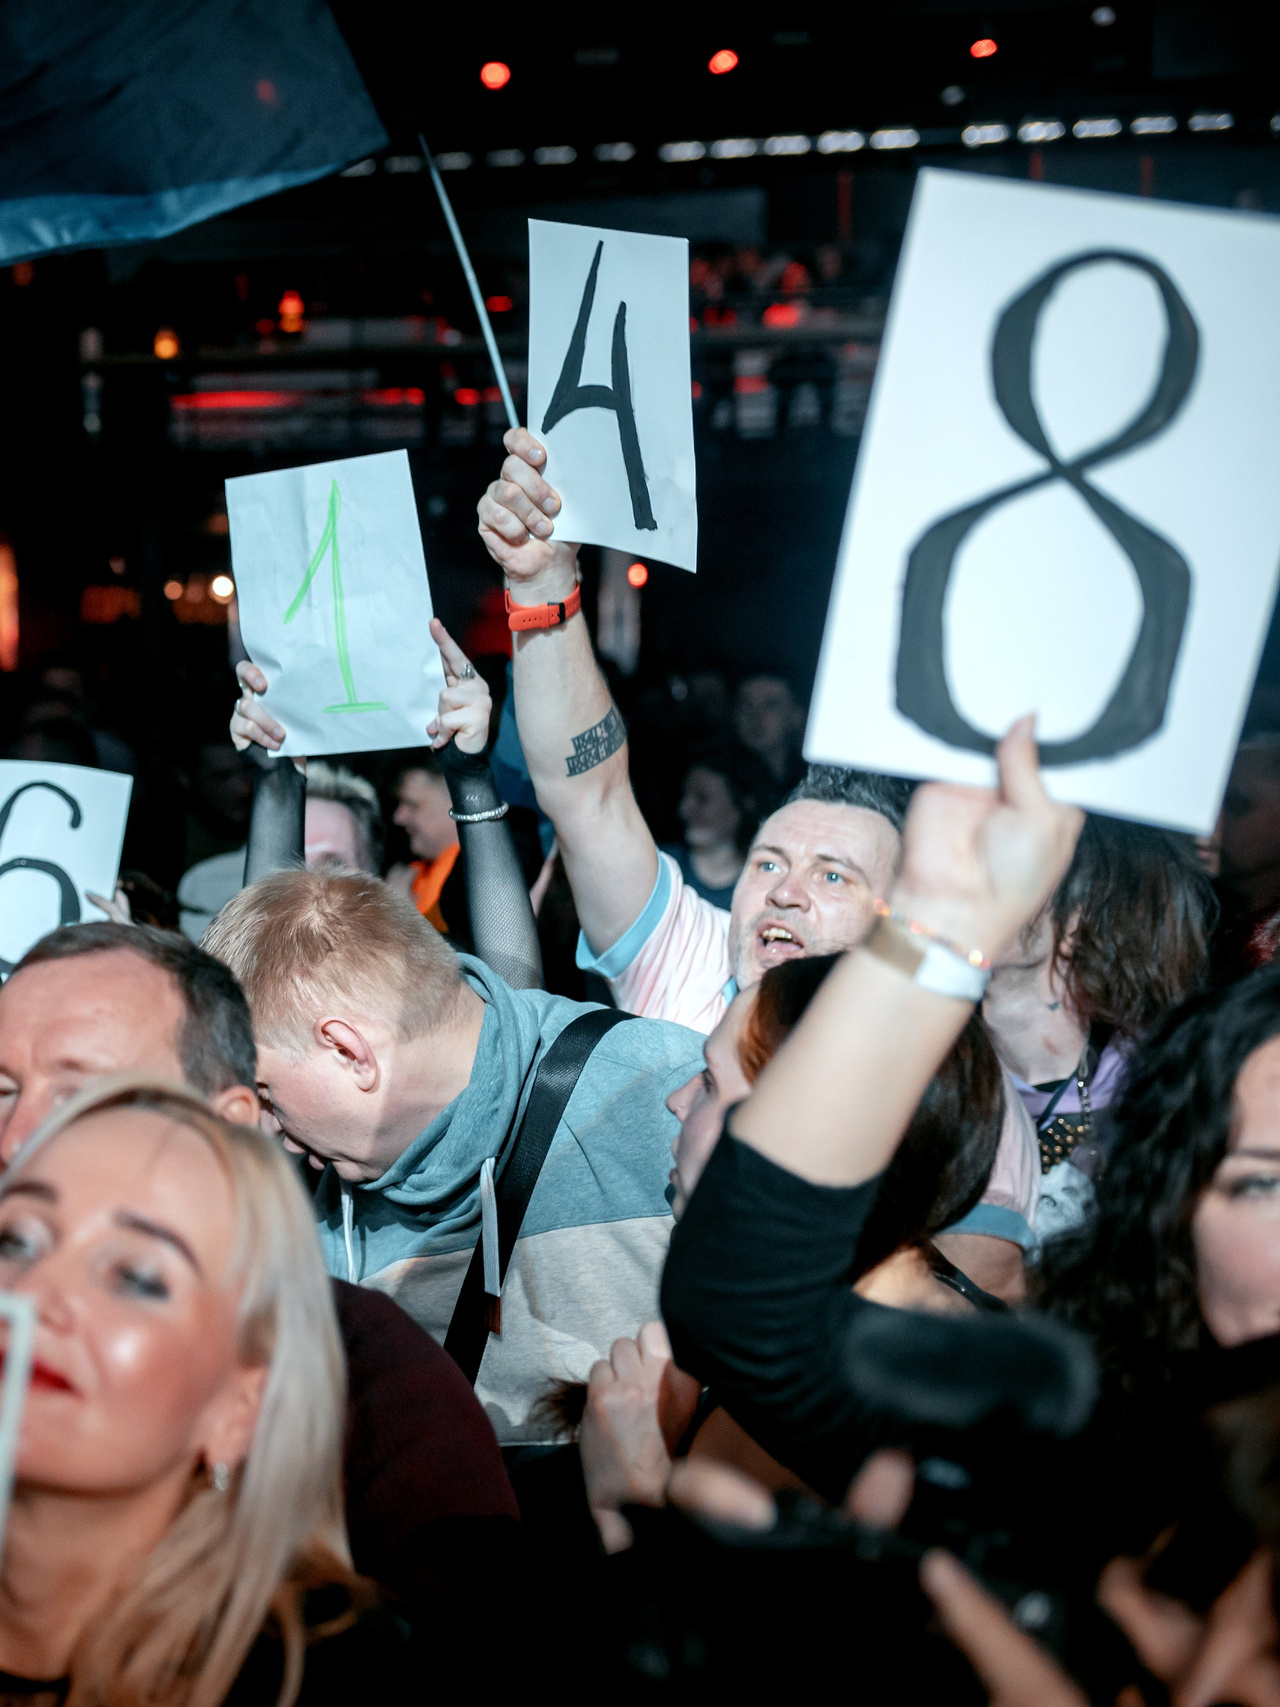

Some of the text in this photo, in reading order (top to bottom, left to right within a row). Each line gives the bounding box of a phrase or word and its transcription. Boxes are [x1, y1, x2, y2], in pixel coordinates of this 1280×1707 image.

[541, 239, 658, 532] 4
[892, 247, 1202, 769] 8
[283, 478, 390, 713] 1
